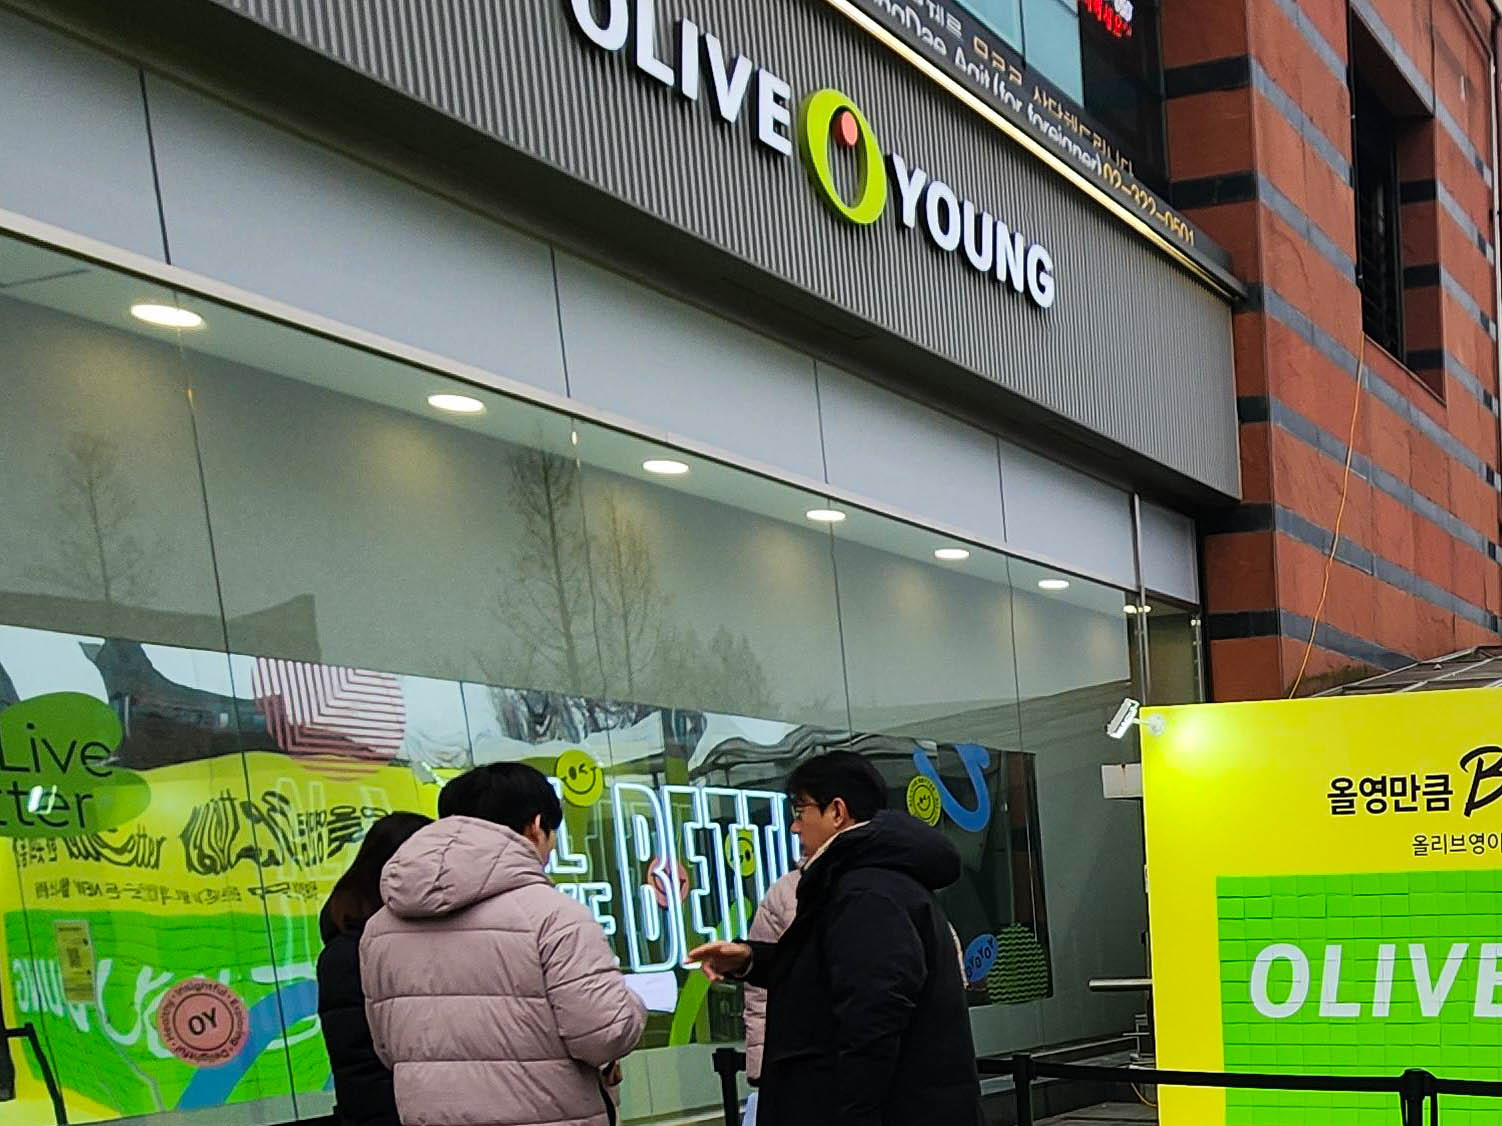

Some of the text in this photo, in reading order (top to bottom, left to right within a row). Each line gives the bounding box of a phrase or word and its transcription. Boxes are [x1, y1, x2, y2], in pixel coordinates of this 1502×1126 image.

[571, 0, 1054, 308] OLIVE YOUNG
[1328, 774, 1453, 815] 올영만큼
[188, 1007, 217, 1036] OY
